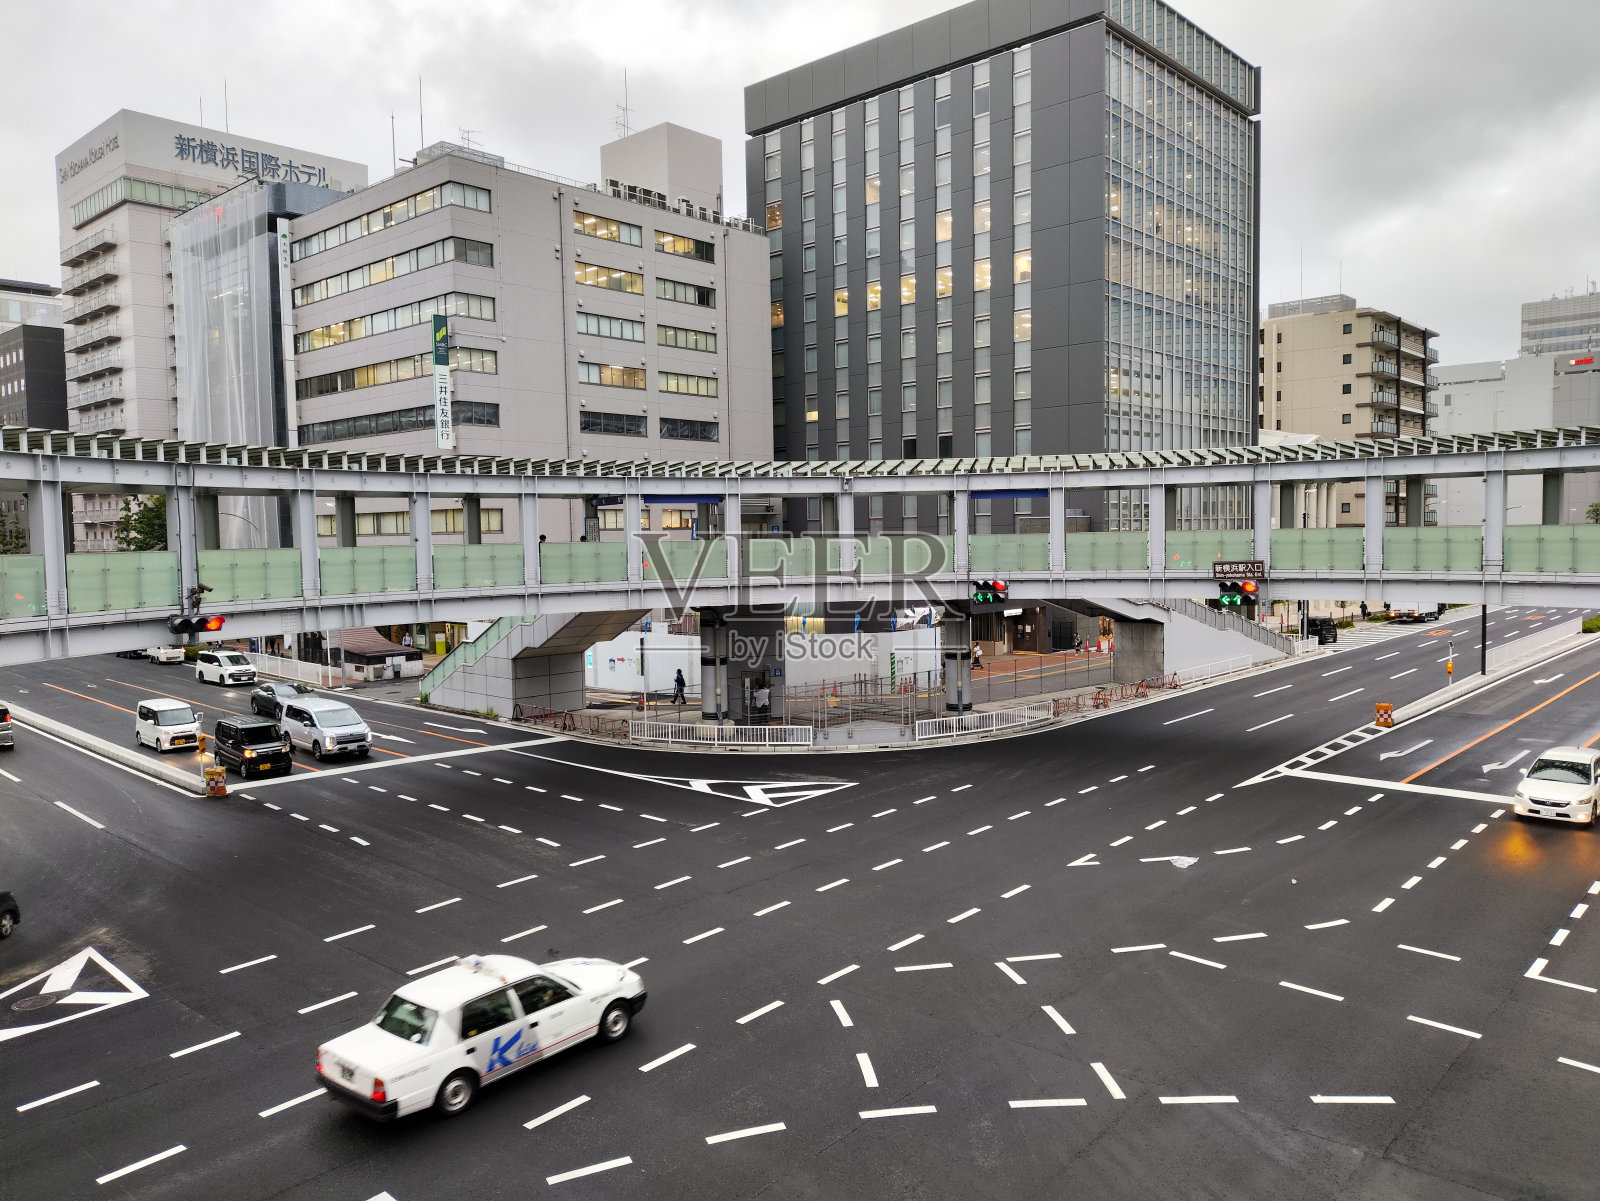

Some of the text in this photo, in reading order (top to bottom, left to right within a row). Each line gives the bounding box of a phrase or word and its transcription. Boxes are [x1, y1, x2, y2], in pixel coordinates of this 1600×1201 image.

[174, 133, 326, 188] 新横浜国際ホテル
[438, 373, 450, 441] 三井住友銀行
[1215, 564, 1262, 572] 新横浜駅入口
